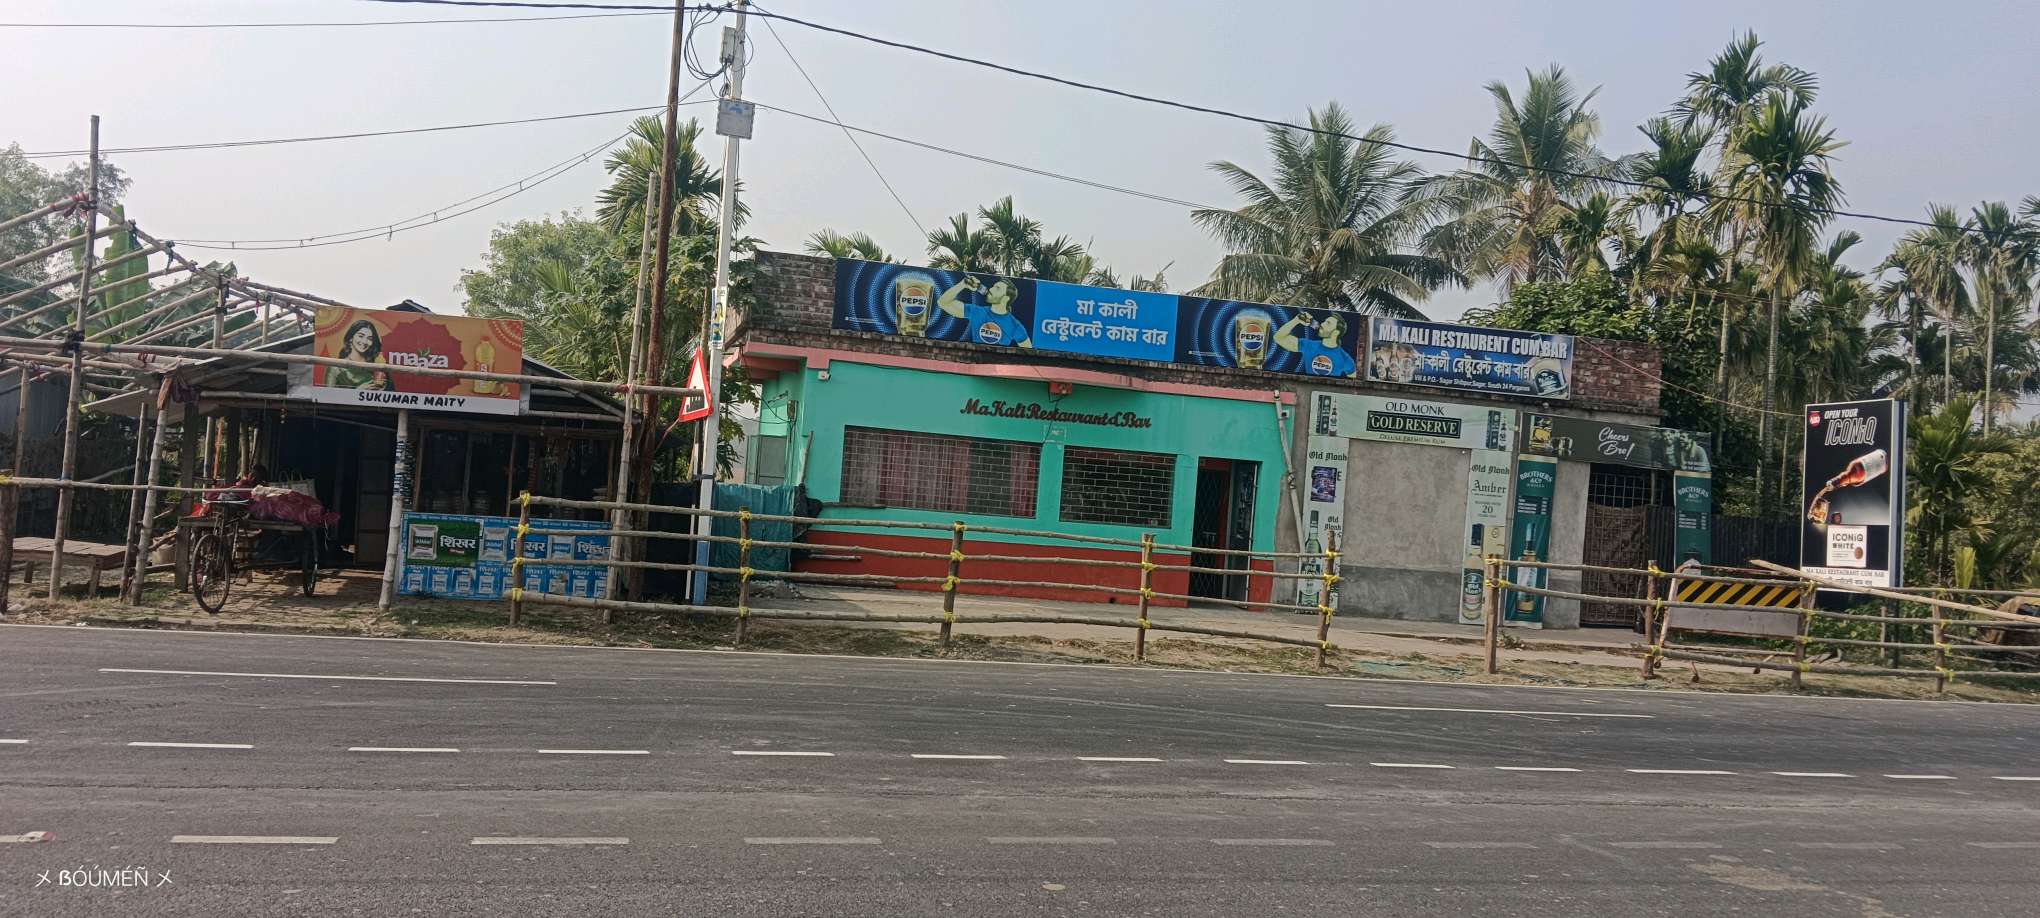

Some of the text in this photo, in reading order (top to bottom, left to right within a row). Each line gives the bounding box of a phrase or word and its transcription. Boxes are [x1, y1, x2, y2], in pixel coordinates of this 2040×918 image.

[901, 297, 926, 306] PEPSI
[1076, 299, 1138, 320] মা কালী
[980, 328, 1001, 338] PEPSI
[1105, 325, 1139, 342] কাম
[1142, 329, 1168, 345] বার
[1240, 333, 1263, 341] PEPSI
[1379, 324, 1567, 359] MA KALI RESTAURENT CUM BAR
[389, 351, 448, 368] maaza
[1313, 361, 1331, 370] PEPSI
[1494, 361, 1513, 377] কাম
[1512, 362, 1530, 380] বার
[359, 391, 465, 407] SUKUMAR MAITY
[960, 398, 992, 414] Ma
[992, 400, 1026, 418] Kali
[1026, 403, 1109, 425] Restaurant
[1121, 412, 1152, 428] Bar
[1385, 402, 1445, 416] OLD MONK
[1824, 408, 1858, 419] OPEN YOUR
[1370, 414, 1457, 434] GOLD RESERVE
[1598, 426, 1629, 442] Cheers
[1309, 452, 1347, 461] Old Monk
[1598, 441, 1635, 460] Bro!
[1472, 464, 1510, 474] Old Monk
[1520, 471, 1553, 483] BROTHERS
[1472, 480, 1507, 494] Amber
[1678, 486, 1709, 498] BROTHERS
[1482, 505, 1493, 514] 20
[440, 535, 476, 549] शिखर
